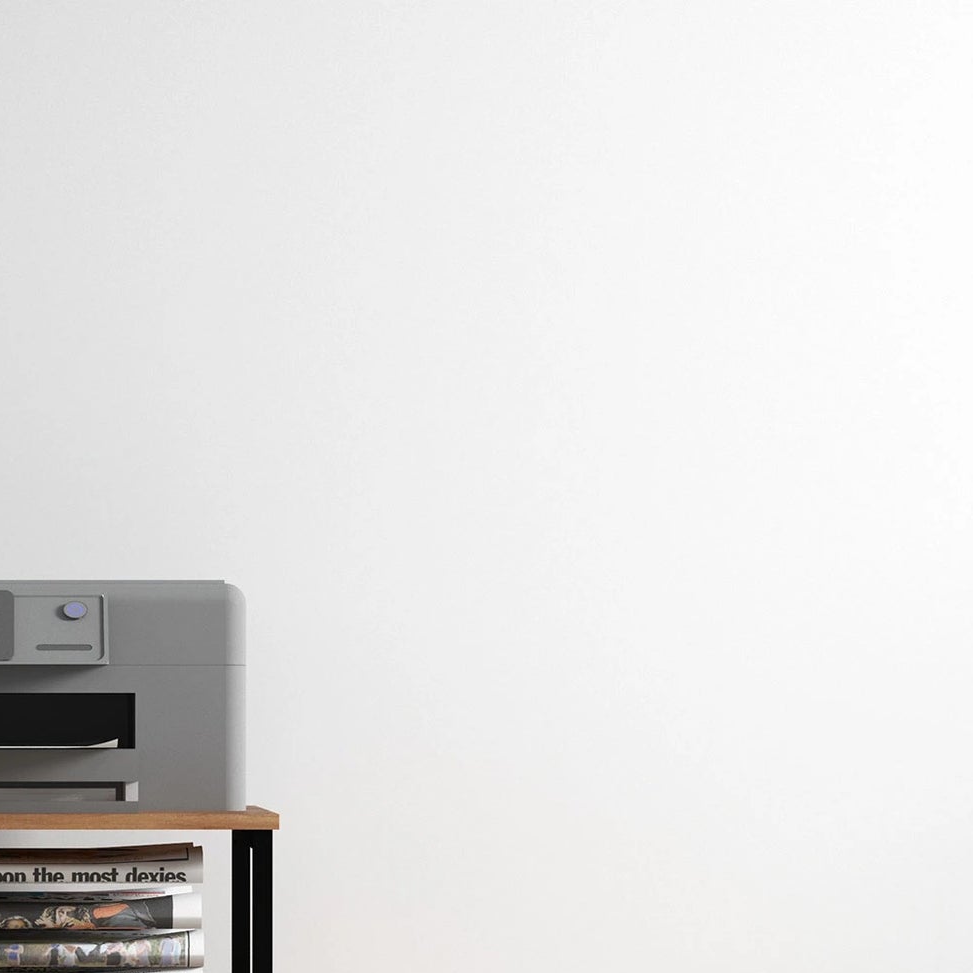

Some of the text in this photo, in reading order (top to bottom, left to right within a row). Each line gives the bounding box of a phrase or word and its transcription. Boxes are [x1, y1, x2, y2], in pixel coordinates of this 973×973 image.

[33, 867, 64, 883] the
[72, 868, 119, 883] most
[126, 867, 187, 883] dexies
